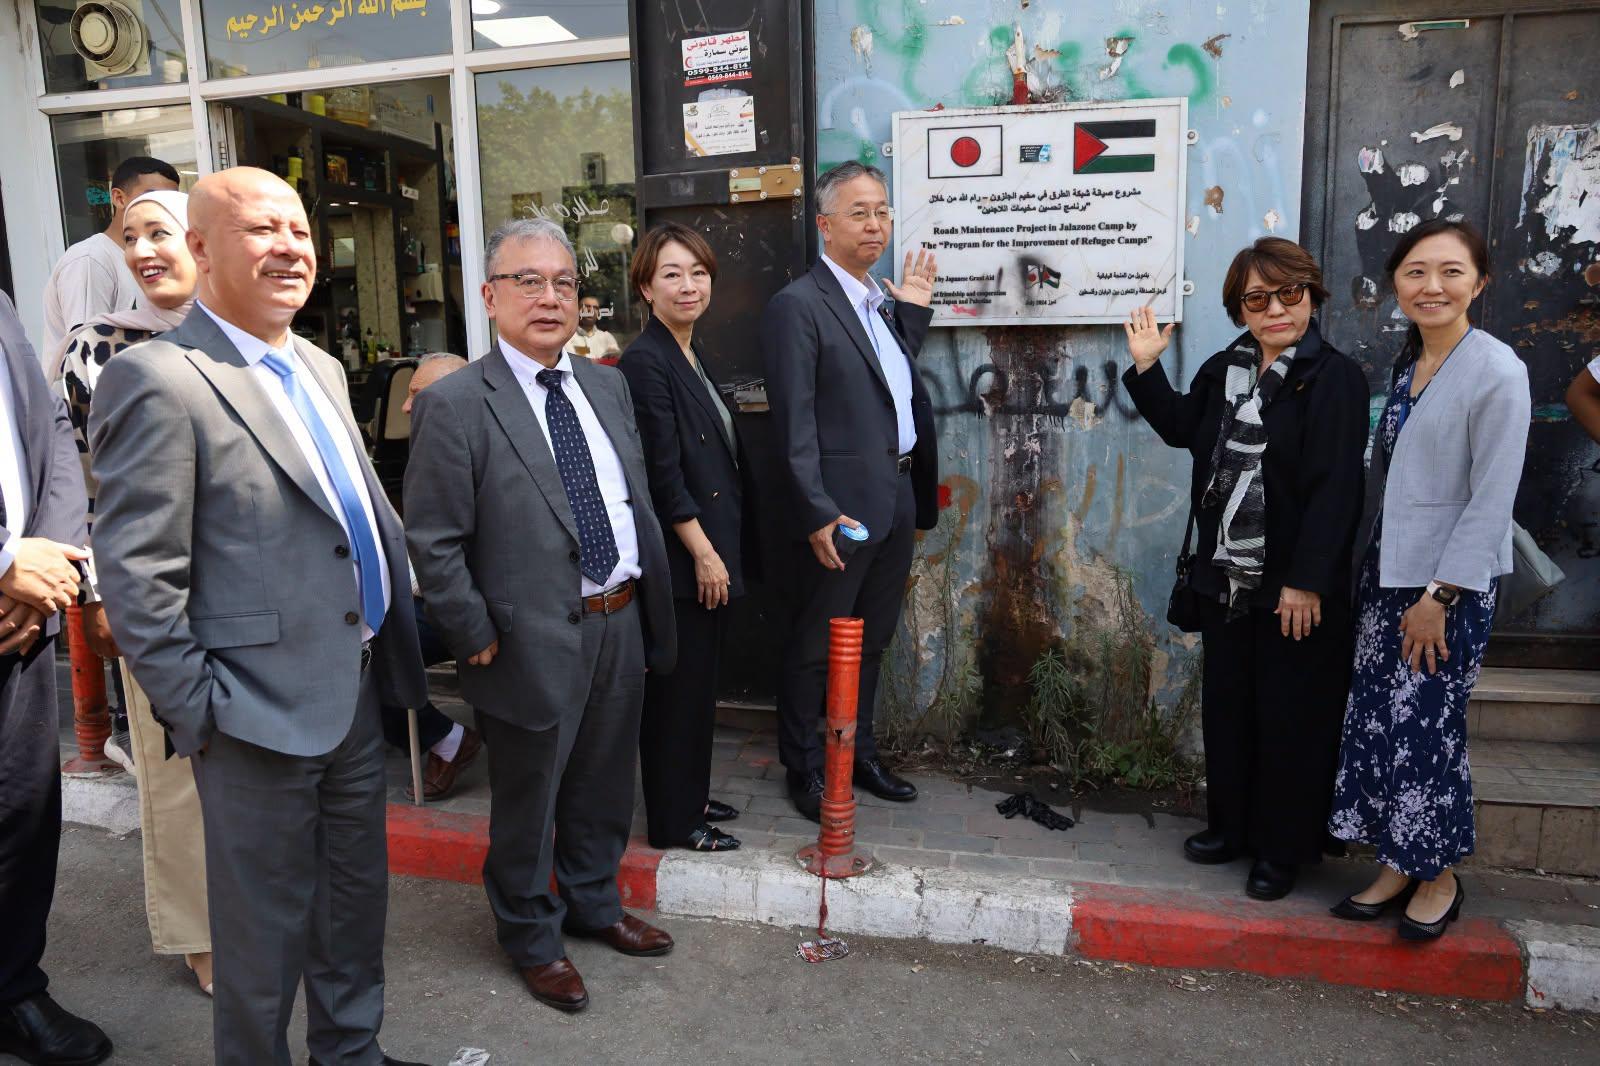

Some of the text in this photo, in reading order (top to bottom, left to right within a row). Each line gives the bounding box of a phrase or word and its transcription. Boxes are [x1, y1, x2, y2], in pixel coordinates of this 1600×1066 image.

[358, 0, 386, 15] الله
[289, 0, 353, 31] الرحمن
[226, 5, 285, 41] الرحيم
[990, 191, 1017, 202] الجلزون
[1037, 189, 1048, 201] في
[1049, 189, 1071, 200] الطرق
[1072, 188, 1091, 199] شبكة
[1092, 187, 1114, 198] صيانة
[1114, 187, 1142, 199] مشروع
[928, 193, 945, 204] خلال
[946, 194, 957, 203] من
[969, 193, 981, 204] رام
[1010, 204, 1037, 214] مخيمات
[1038, 203, 1062, 213] تحسين
[933, 221, 1137, 235] Roads Maintenance Project in Jalazone Camp by
[921, 241, 937, 250] The
[982, 239, 995, 248] for
[996, 239, 1010, 248] the
[1012, 237, 1069, 249] Improvement
[1070, 237, 1080, 246] of
[1081, 236, 1116, 247] Refugee
[938, 275, 945, 283] by
[945, 275, 968, 284] Japanese
[969, 274, 985, 282] Grant
[1134, 271, 1150, 280] بتمويل
[939, 290, 966, 298] friendship
[1078, 288, 1098, 296] وفلسطين
[942, 298, 958, 306] Japan
